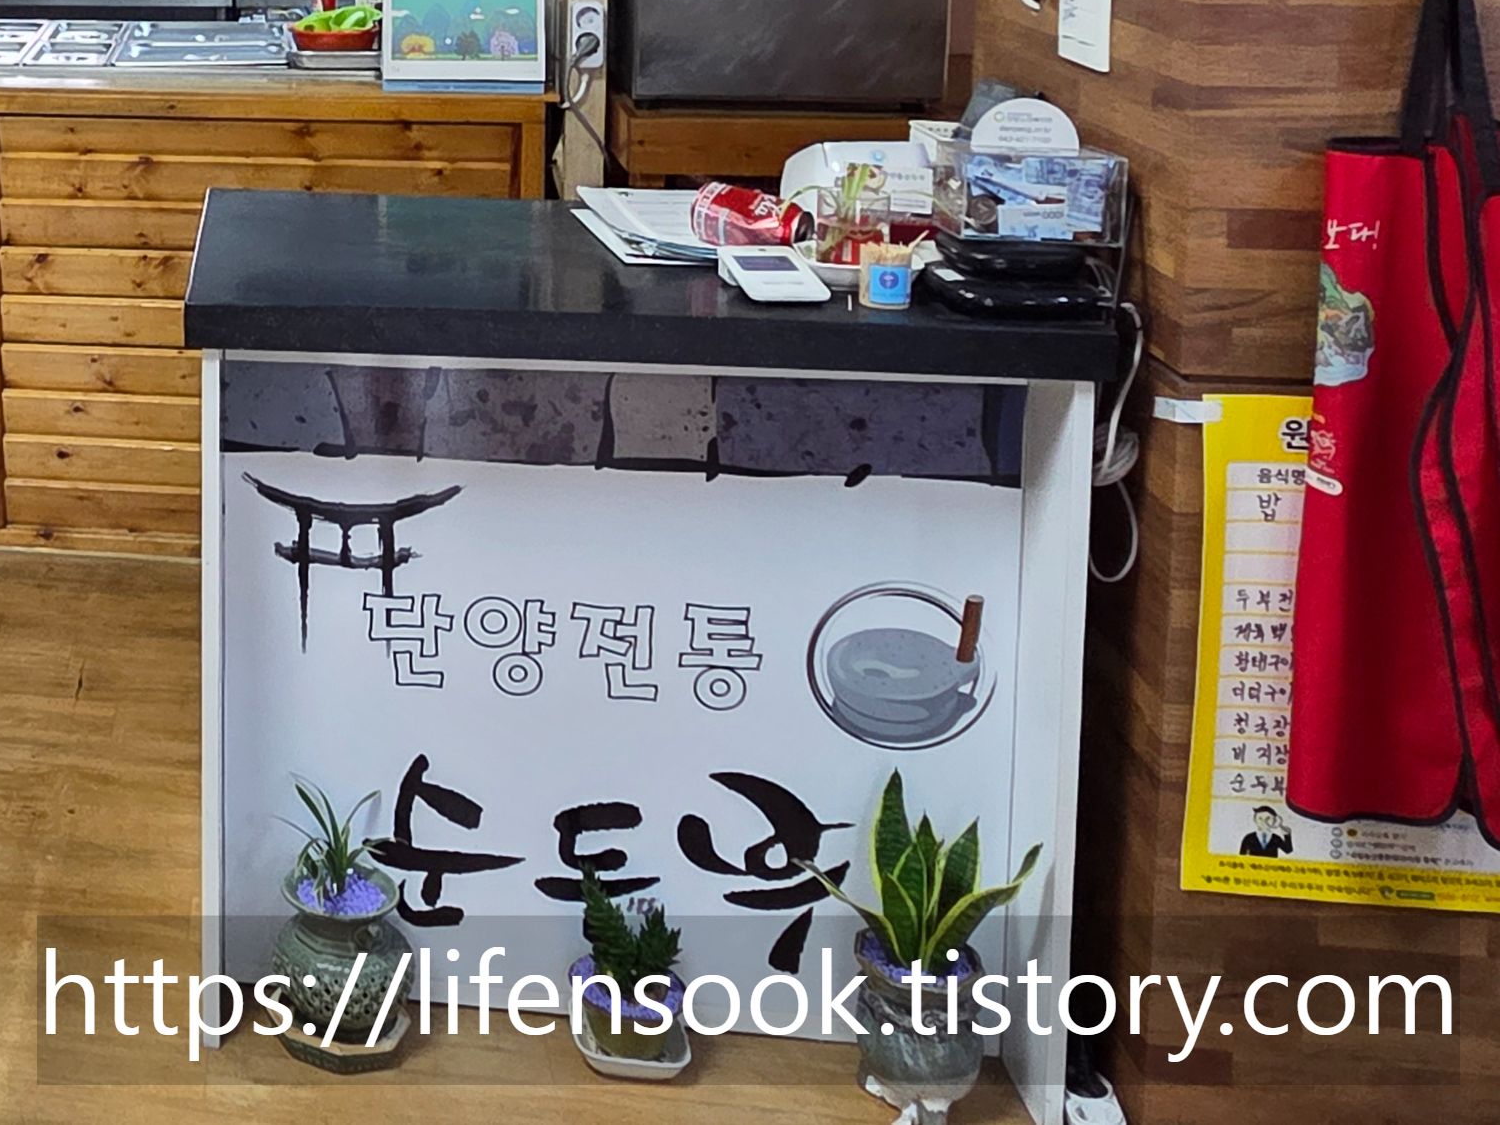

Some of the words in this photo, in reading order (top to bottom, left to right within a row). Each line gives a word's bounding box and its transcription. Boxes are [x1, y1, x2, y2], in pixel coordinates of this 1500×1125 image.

[1257, 468, 1307, 485] 음식명
[1257, 493, 1282, 522] 밥
[363, 593, 763, 710] 단양전통
[1233, 712, 1290, 737] 청국장
[1232, 742, 1290, 766] 비지장
[1229, 773, 1287, 797] 순두부
